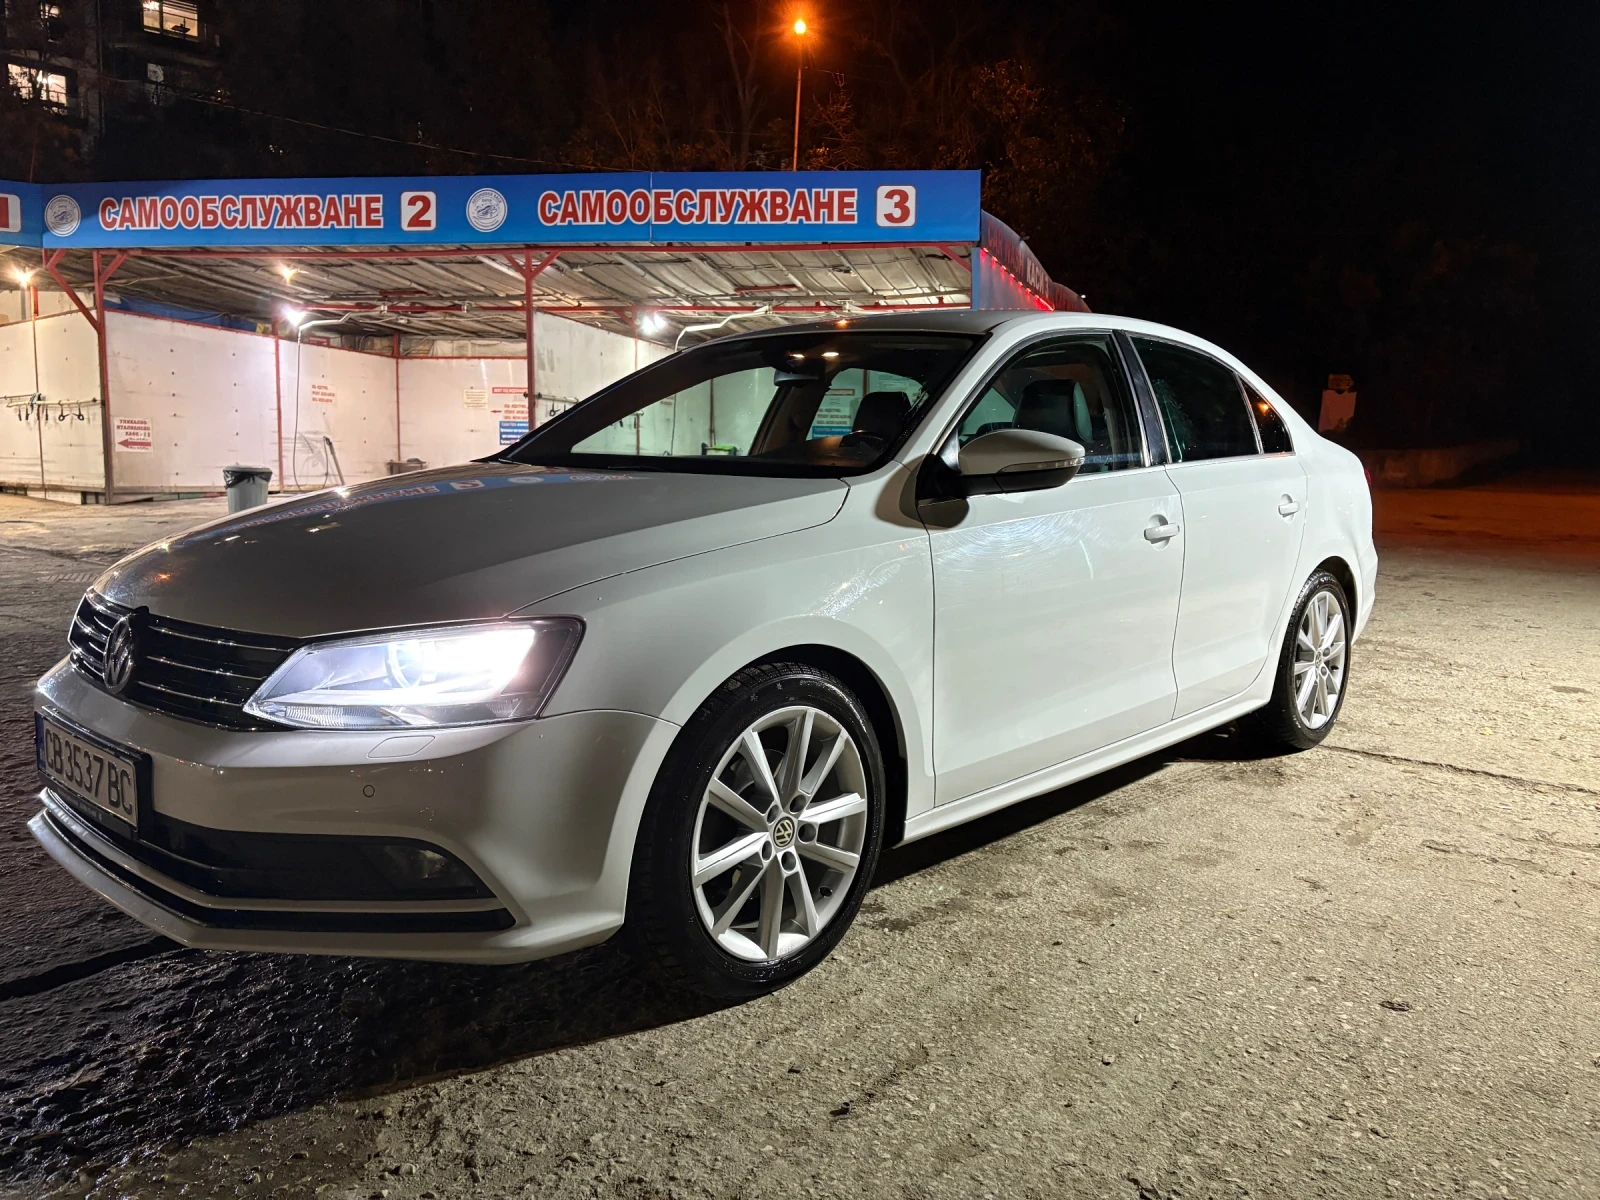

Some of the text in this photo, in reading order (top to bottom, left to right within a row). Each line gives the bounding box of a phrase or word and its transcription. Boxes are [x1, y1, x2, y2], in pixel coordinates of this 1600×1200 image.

[99, 195, 383, 230] САМООБСЛУЖВАНЕ
[407, 194, 432, 228] 2
[538, 188, 911, 226] САМООБСЛУЖВАНЕ 3
